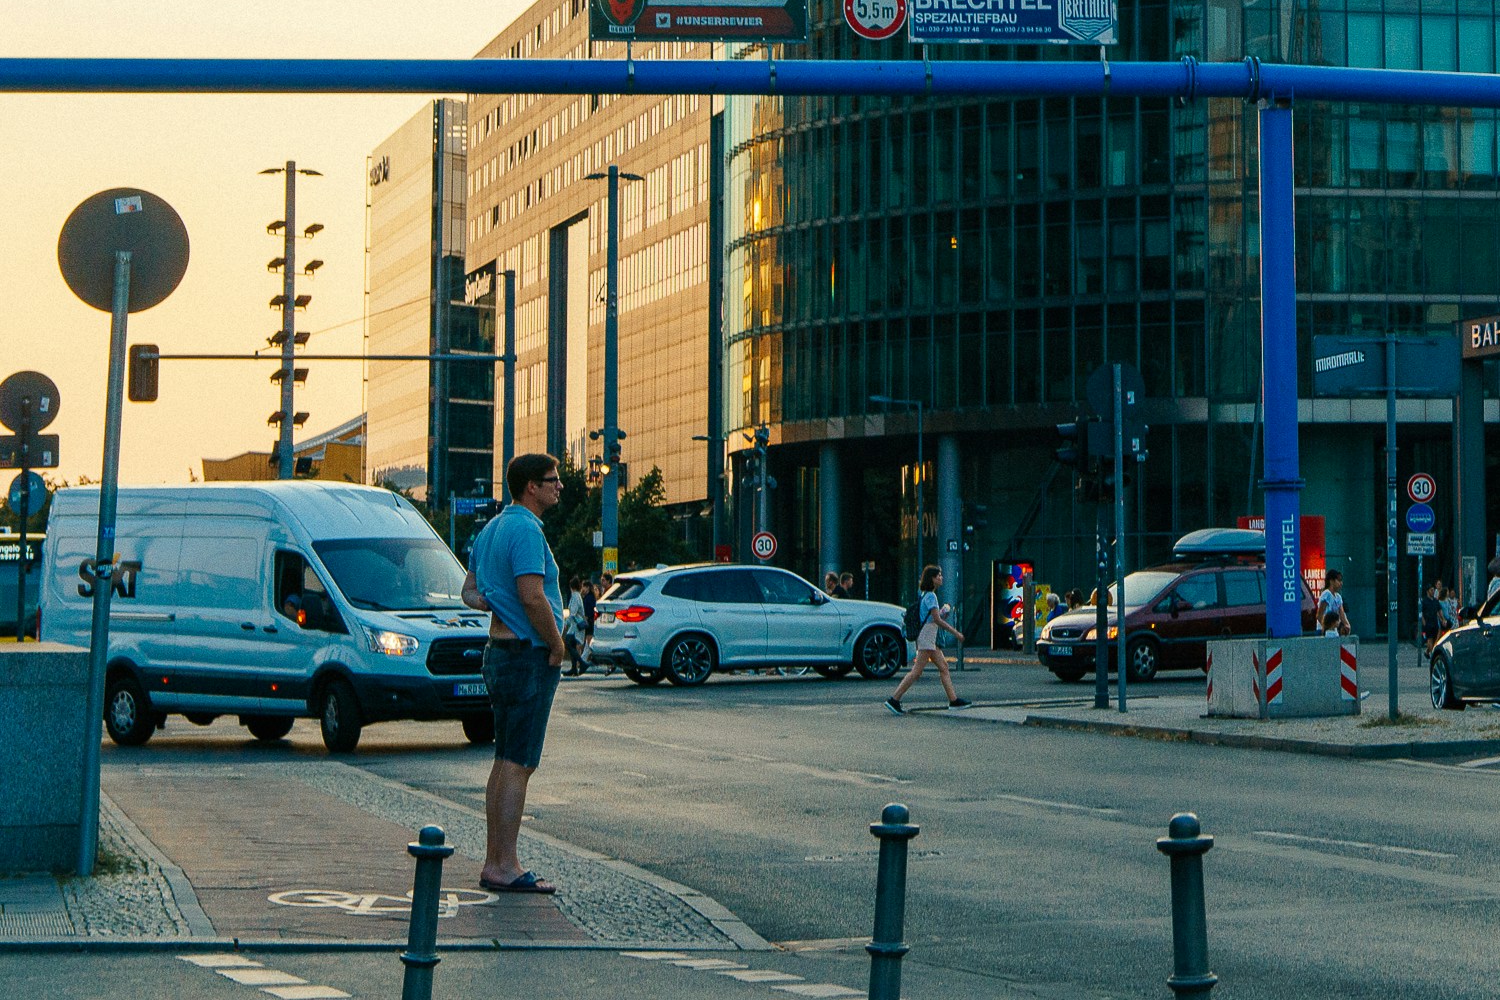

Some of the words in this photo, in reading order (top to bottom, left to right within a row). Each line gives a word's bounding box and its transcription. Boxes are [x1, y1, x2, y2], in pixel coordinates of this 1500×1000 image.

[676, 16, 763, 27] #UNSERREVIER
[915, 12, 1017, 24] SPEZIALTIEFBAU
[1414, 481, 1430, 496] 30
[757, 538, 772, 552] 30
[1281, 513, 1296, 602] BRECHTEL
[78, 558, 143, 599] SXT
